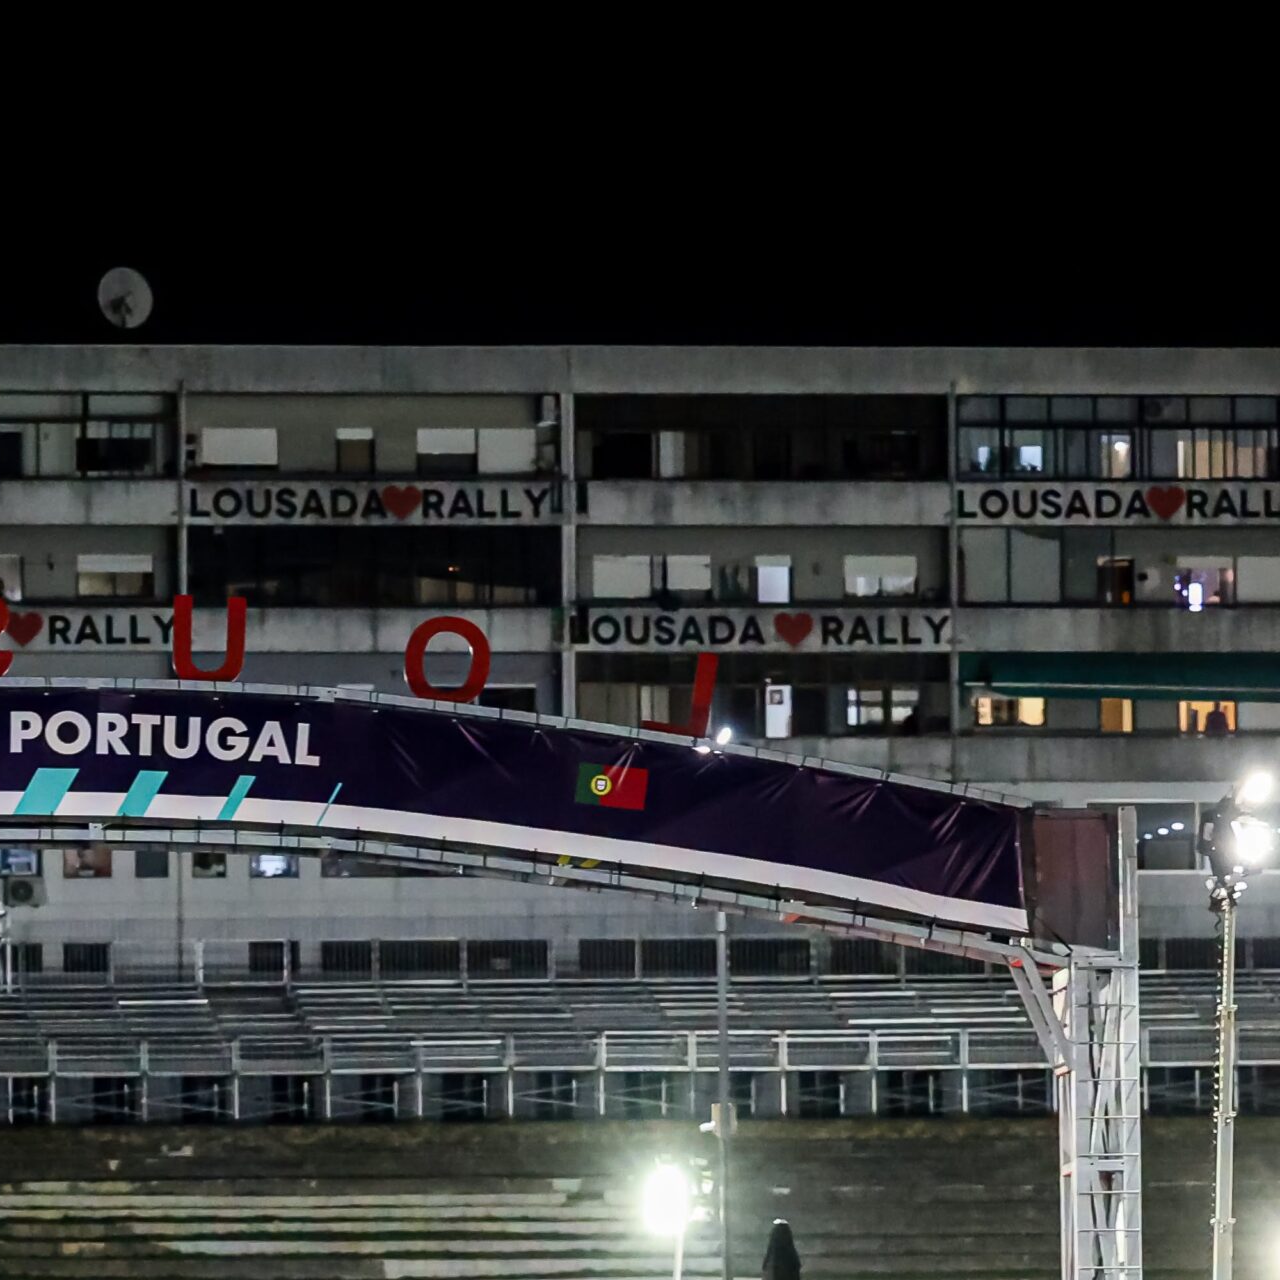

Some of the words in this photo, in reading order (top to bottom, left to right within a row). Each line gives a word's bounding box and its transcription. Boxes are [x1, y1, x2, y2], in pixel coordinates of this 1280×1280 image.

[190, 487, 388, 519] LOUSADA
[422, 488, 550, 519] RALLY
[957, 488, 1151, 519] LOUSADA
[48, 614, 175, 645] RALLY
[569, 614, 766, 645] LOUSADA
[822, 615, 950, 645] RALLY
[10, 710, 321, 767] PORTUGAL
